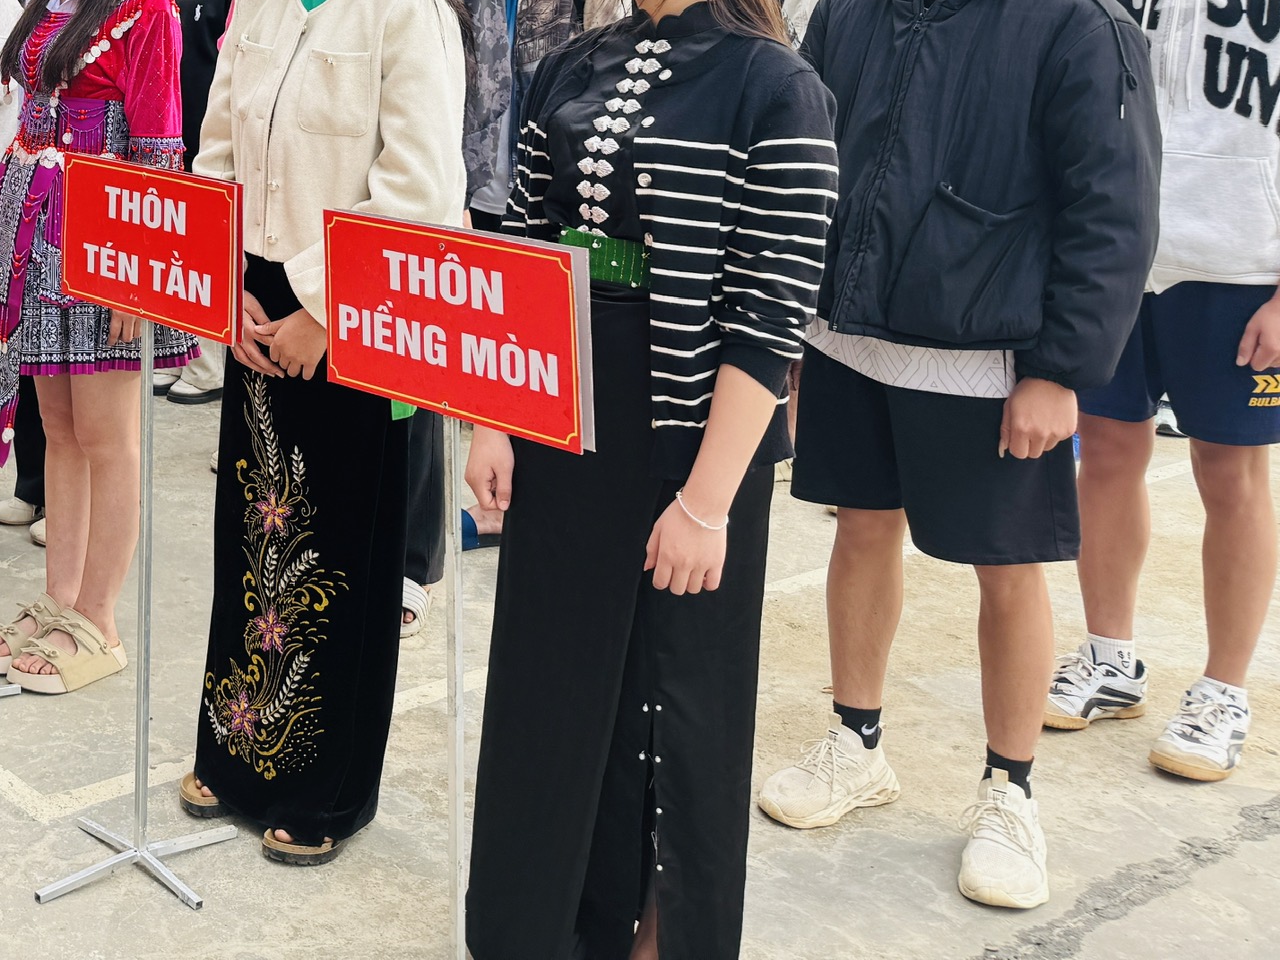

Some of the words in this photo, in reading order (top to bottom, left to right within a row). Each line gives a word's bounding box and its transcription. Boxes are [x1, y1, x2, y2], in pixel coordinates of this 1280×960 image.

[104, 185, 187, 237] THÔN
[82, 240, 139, 286] TÉN
[149, 250, 212, 308] TẰN
[382, 250, 505, 315] THÔN
[338, 299, 448, 368] PIỀNG
[461, 330, 559, 398] MÒN
